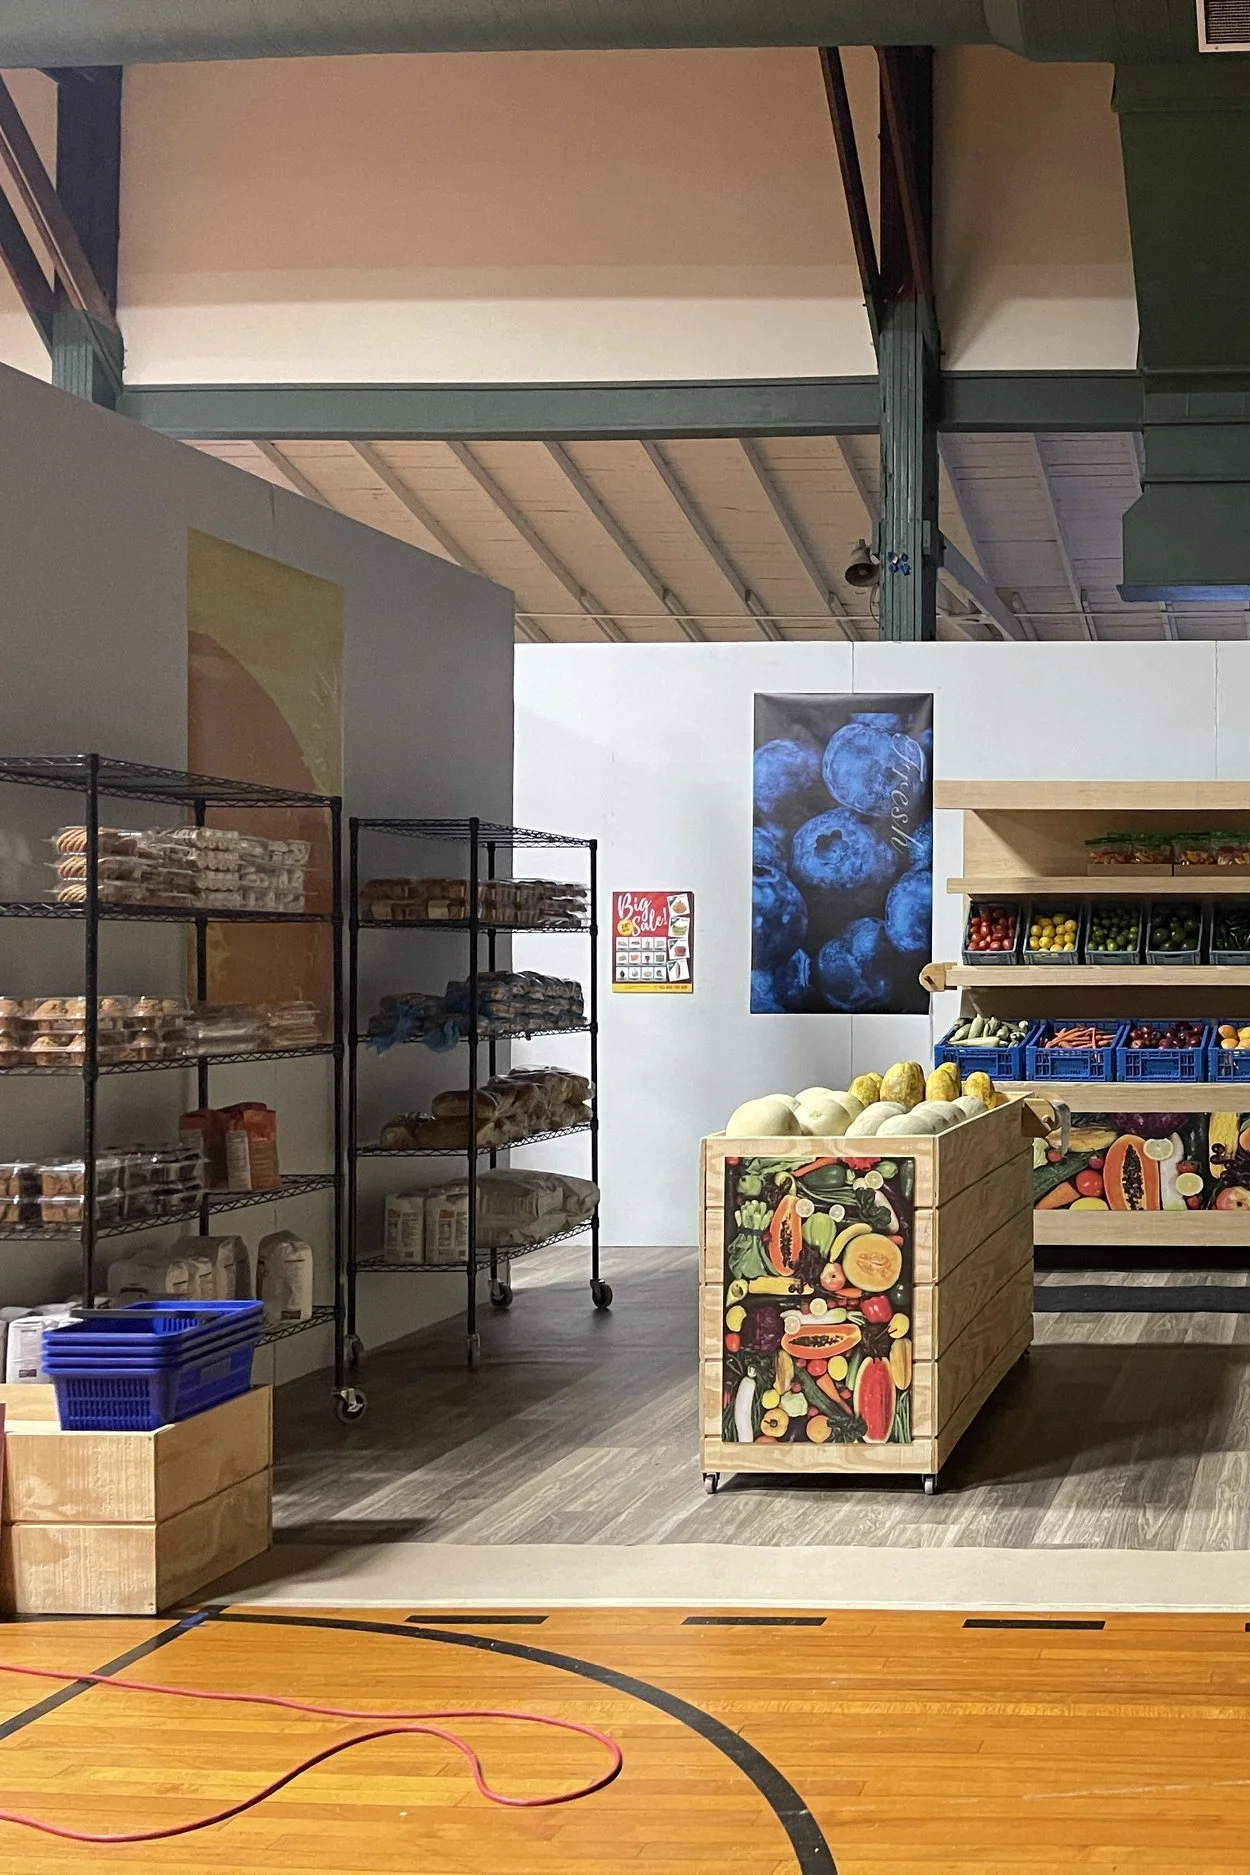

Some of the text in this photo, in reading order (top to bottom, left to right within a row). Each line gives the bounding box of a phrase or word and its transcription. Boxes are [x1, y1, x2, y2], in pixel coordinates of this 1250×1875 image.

[890, 733, 924, 855] Fresh
[617, 893, 652, 922] Big
[632, 907, 668, 937] Sale!
